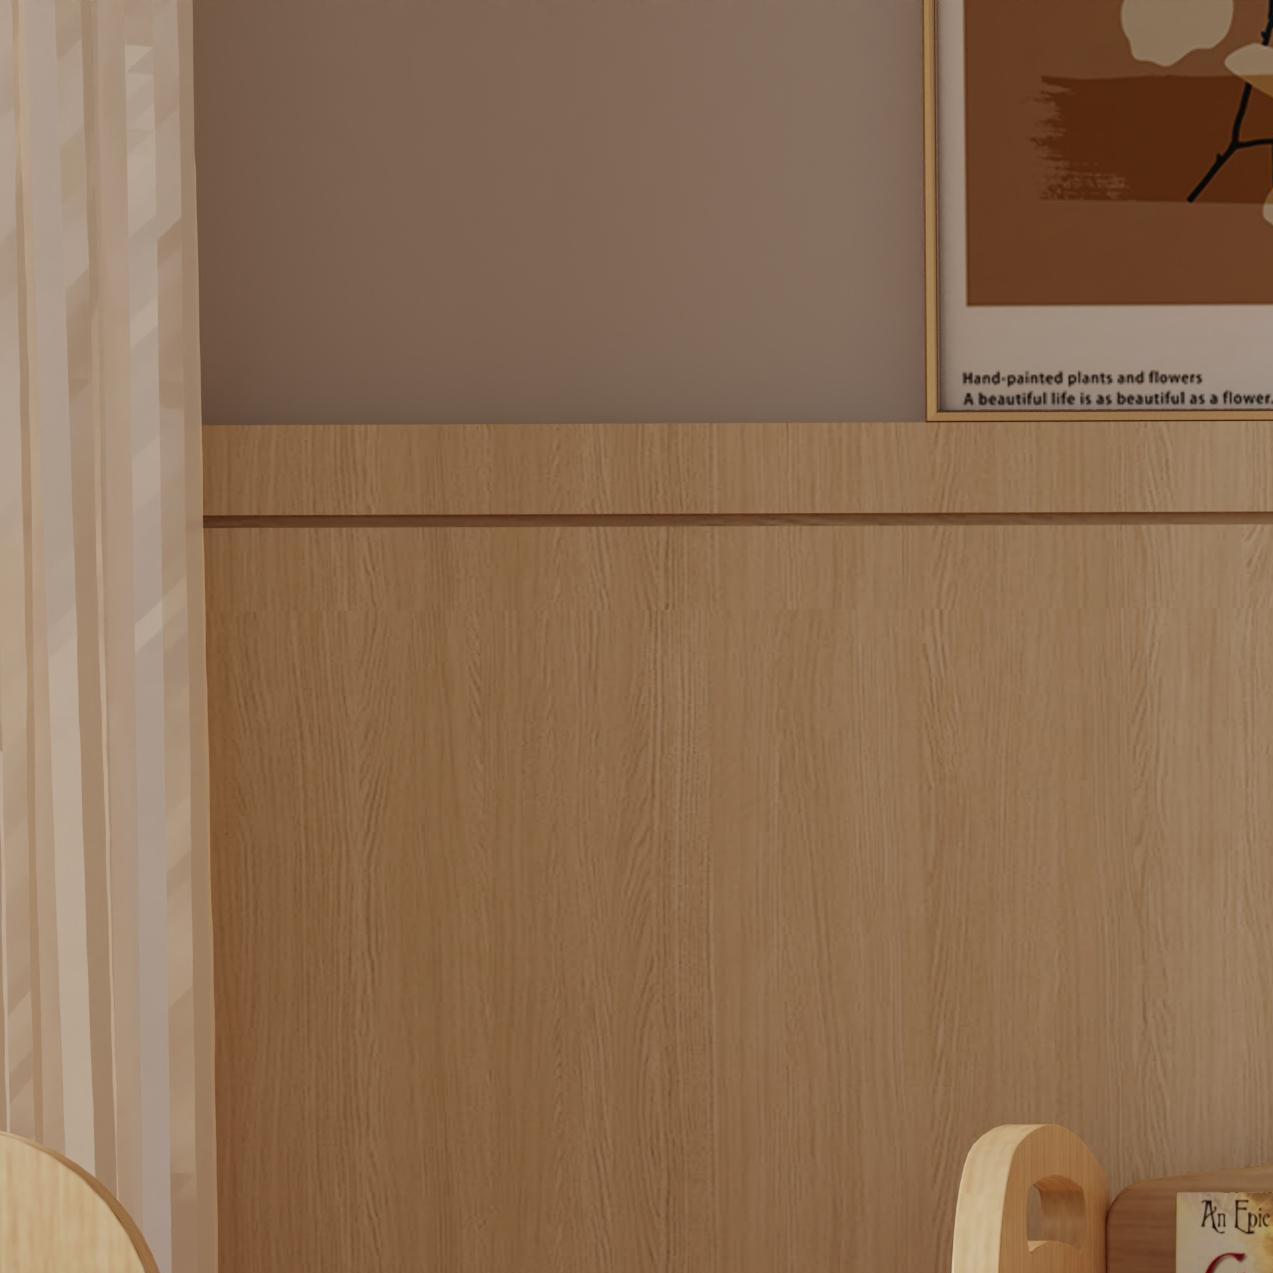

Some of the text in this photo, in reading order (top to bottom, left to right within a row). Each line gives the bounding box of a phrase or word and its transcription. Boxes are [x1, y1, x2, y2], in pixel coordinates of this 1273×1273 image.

[962, 371, 1203, 387] Hand-painted plants and flowers
[963, 392, 975, 405] A
[978, 391, 1047, 405] beautiful
[1051, 391, 1076, 405] life
[1080, 391, 1092, 405] is
[1096, 394, 1113, 405] as
[1117, 391, 1186, 405] beautiful
[1189, 394, 1206, 405] as
[1209, 394, 1219, 405] a
[1201, 1199, 1227, 1234] An
[1234, 1200, 1270, 1234] Epic
